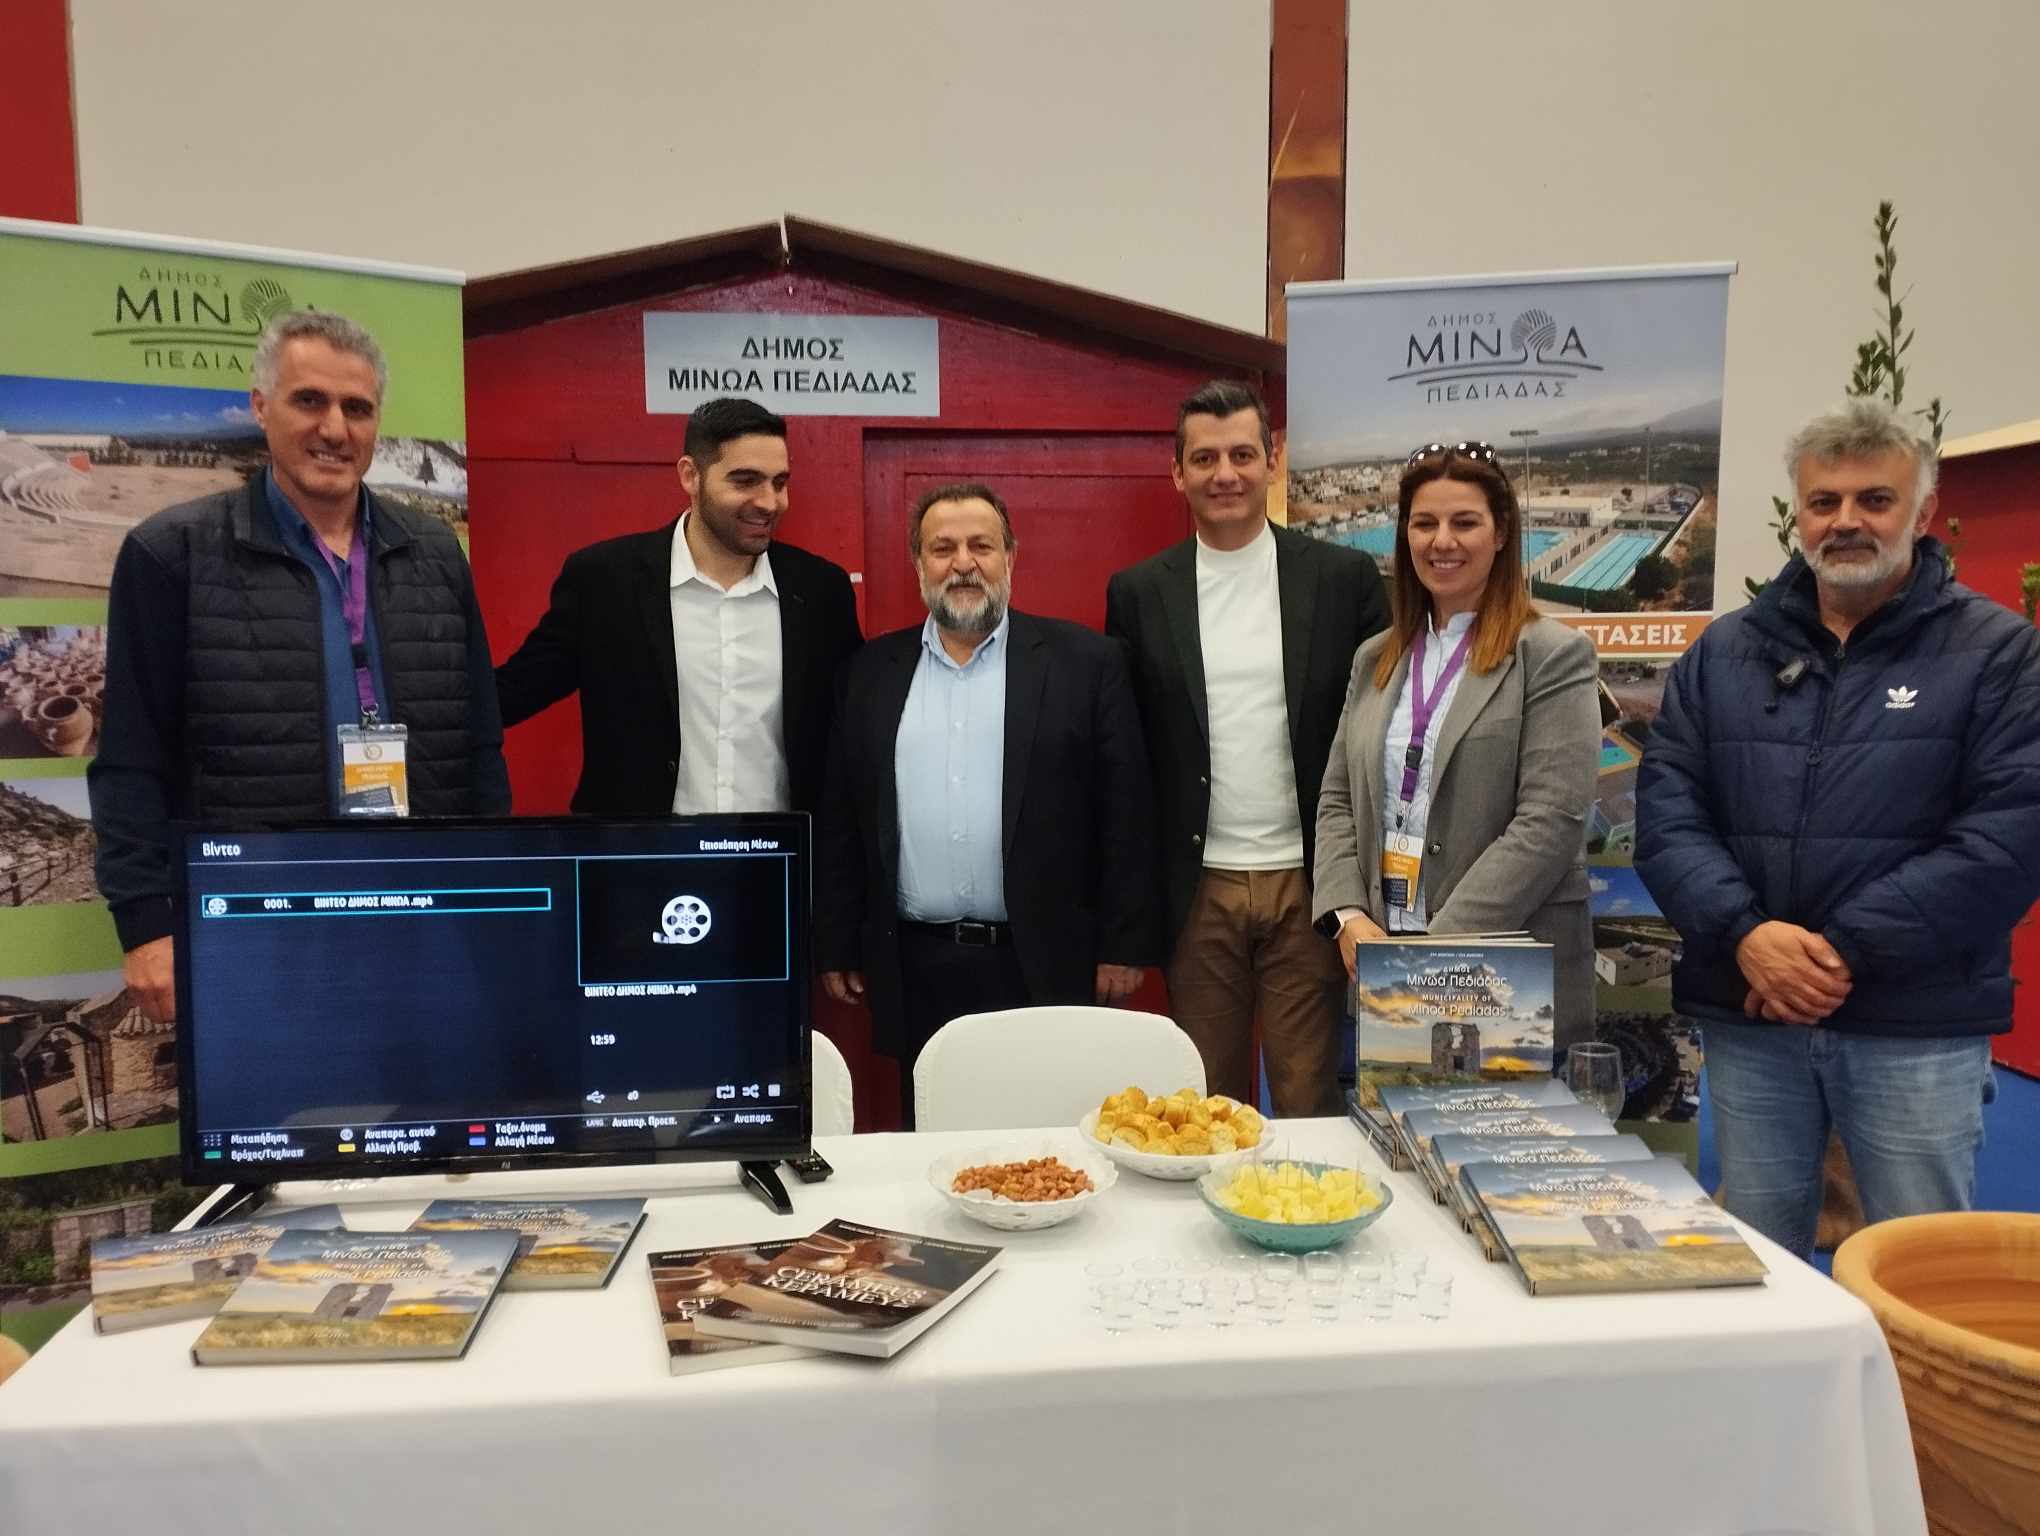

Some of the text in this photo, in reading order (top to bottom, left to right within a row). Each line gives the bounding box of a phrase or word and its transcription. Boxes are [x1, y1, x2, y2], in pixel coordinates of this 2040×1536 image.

[139, 266, 222, 289] ΔΗΜΟΣ
[1427, 312, 1497, 329] ΔΗΜΟΣ
[741, 337, 845, 361] ΔΗΜΟΣ
[144, 349, 256, 374] ΠΕΔΙΑ
[668, 368, 917, 394] ΜΙΝΩΑ ΠΕΔΙΑΔΑΣ
[1427, 381, 1567, 404] ΠΕΔΙΑΔΑΣ
[264, 898, 292, 910] 0001.
[1407, 974, 1508, 987] Μινώα Πεδιάδας
[590, 1034, 616, 1046] 12:59
